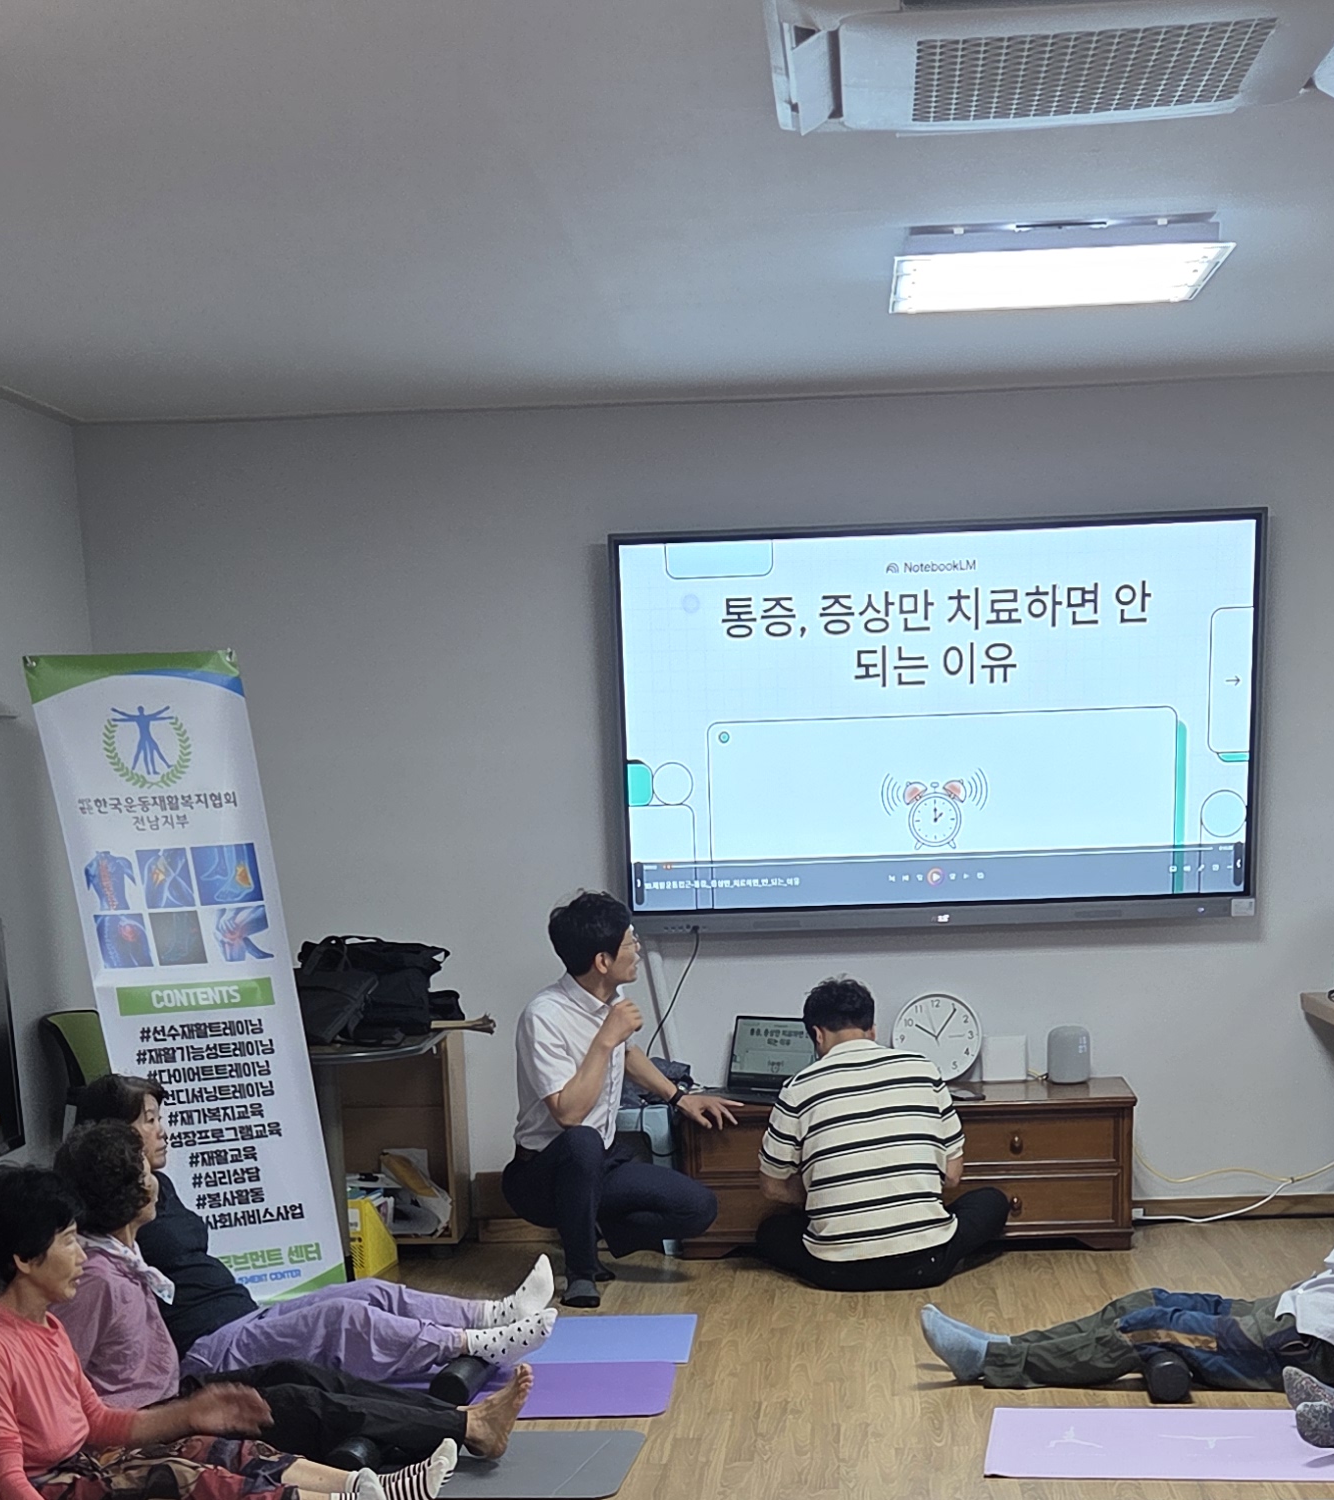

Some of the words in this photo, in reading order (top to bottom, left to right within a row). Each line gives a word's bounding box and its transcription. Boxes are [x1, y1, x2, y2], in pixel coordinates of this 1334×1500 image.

[903, 559, 977, 574] NotebookLM
[721, 596, 807, 639] 통증,
[819, 588, 935, 636] 증상만
[946, 582, 1100, 631] 치료하면
[1115, 580, 1152, 625] 안
[854, 644, 929, 688] 되는
[942, 642, 1017, 686] 이유
[94, 791, 238, 815] 한국운동재활복지협회
[132, 813, 189, 831] 전남지부
[150, 985, 241, 1009] CONTENTS
[962, 1014, 969, 1024] 2
[140, 1019, 264, 1043] #선수재활트레이닝
[899, 1034, 906, 1044] 9
[967, 1030, 974, 1040] 3
[136, 1039, 275, 1065] #재활기능성트레이닝
[168, 1103, 264, 1127] #재가복지교육
[166, 1121, 282, 1148] 성장프로그램교육
[189, 1146, 258, 1167] #재활교육
[192, 1166, 261, 1188] #심리상담
[196, 1187, 265, 1209] #봉사활동
[205, 1203, 305, 1230] 사회서비스사업
[287, 1242, 323, 1265] 센터
[269, 1269, 302, 1281] CENTER
